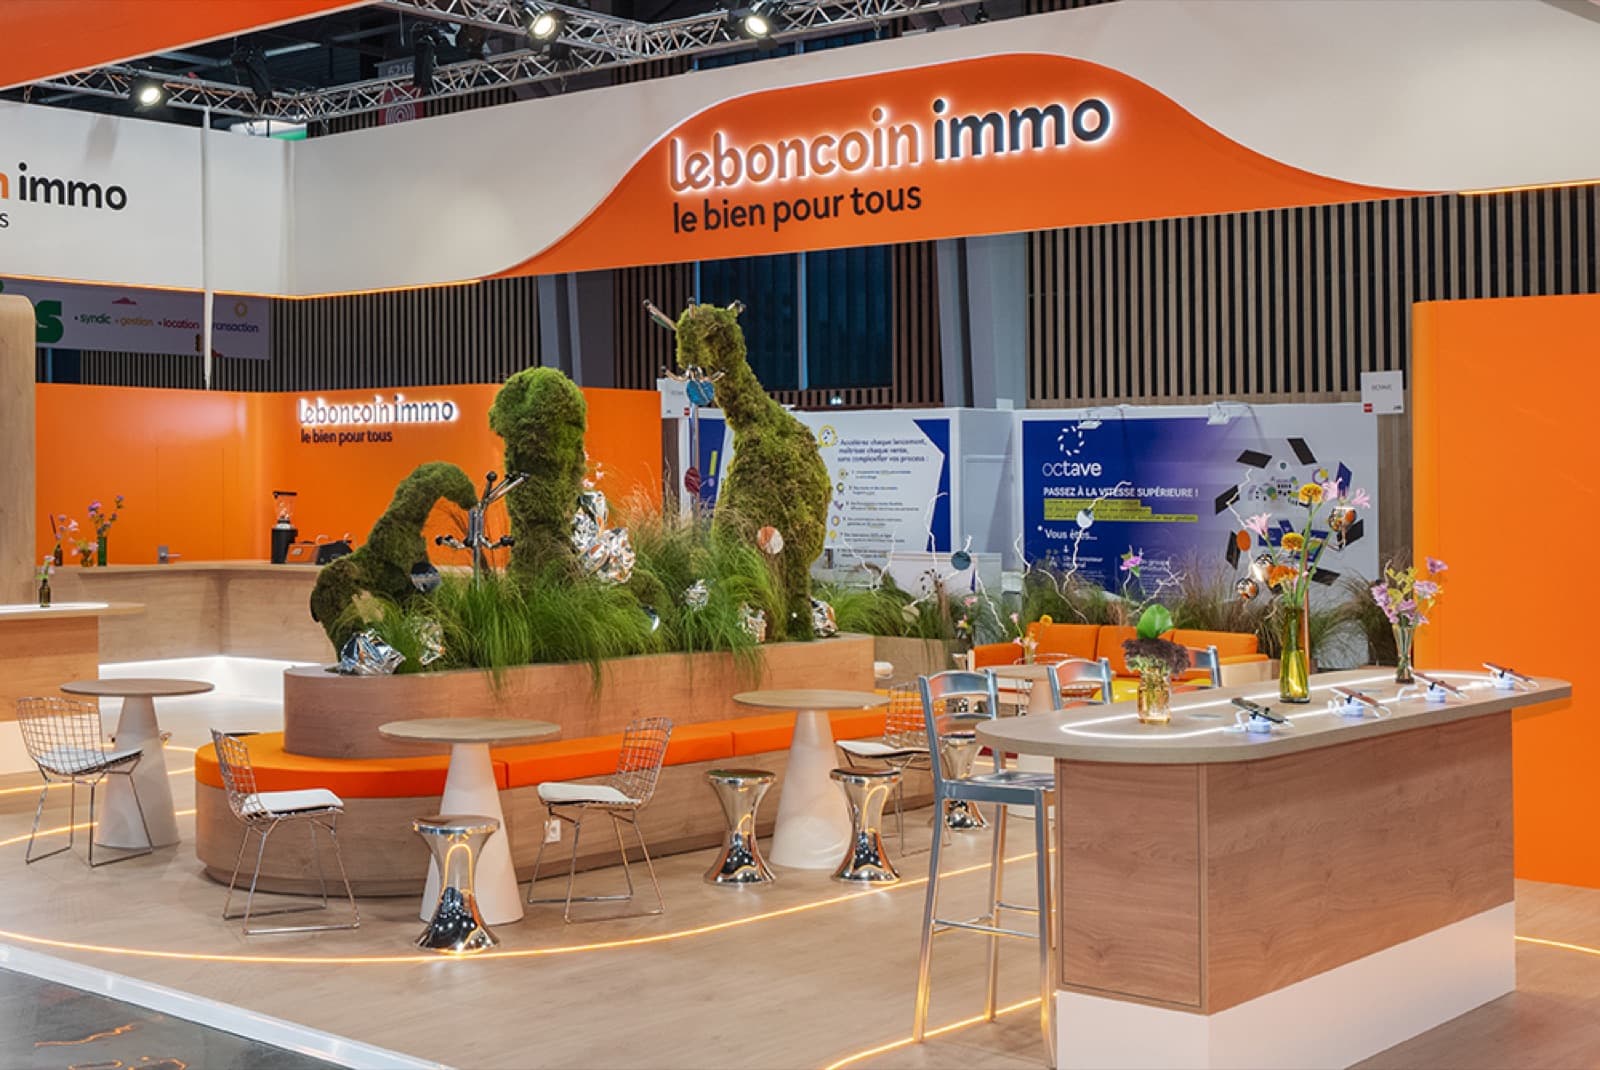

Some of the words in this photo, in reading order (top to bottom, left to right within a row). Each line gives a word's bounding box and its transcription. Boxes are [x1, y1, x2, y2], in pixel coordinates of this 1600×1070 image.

[668, 106, 921, 192] leboncoin
[932, 98, 1111, 160] immo
[18, 162, 128, 211] immo
[673, 201, 698, 234] le
[704, 197, 766, 231] bien
[773, 193, 845, 233] pour
[850, 184, 922, 216] tous
[80, 313, 111, 326] syndic
[120, 316, 153, 328] gestion
[163, 318, 200, 330] location
[212, 320, 259, 333] ransaction
[298, 395, 390, 424] leboncoin
[394, 393, 454, 422] immo
[301, 428, 312, 443] le
[313, 428, 337, 443] bien
[338, 431, 365, 446] pour
[367, 429, 393, 443] tous
[1042, 461, 1102, 477] octave
[1043, 487, 1076, 497] PASSEZ
[1077, 485, 1085, 497] À
[1085, 487, 1098, 497] LA
[1136, 485, 1194, 498] SUPÉRIEURE
[1044, 527, 1068, 539] Vous
